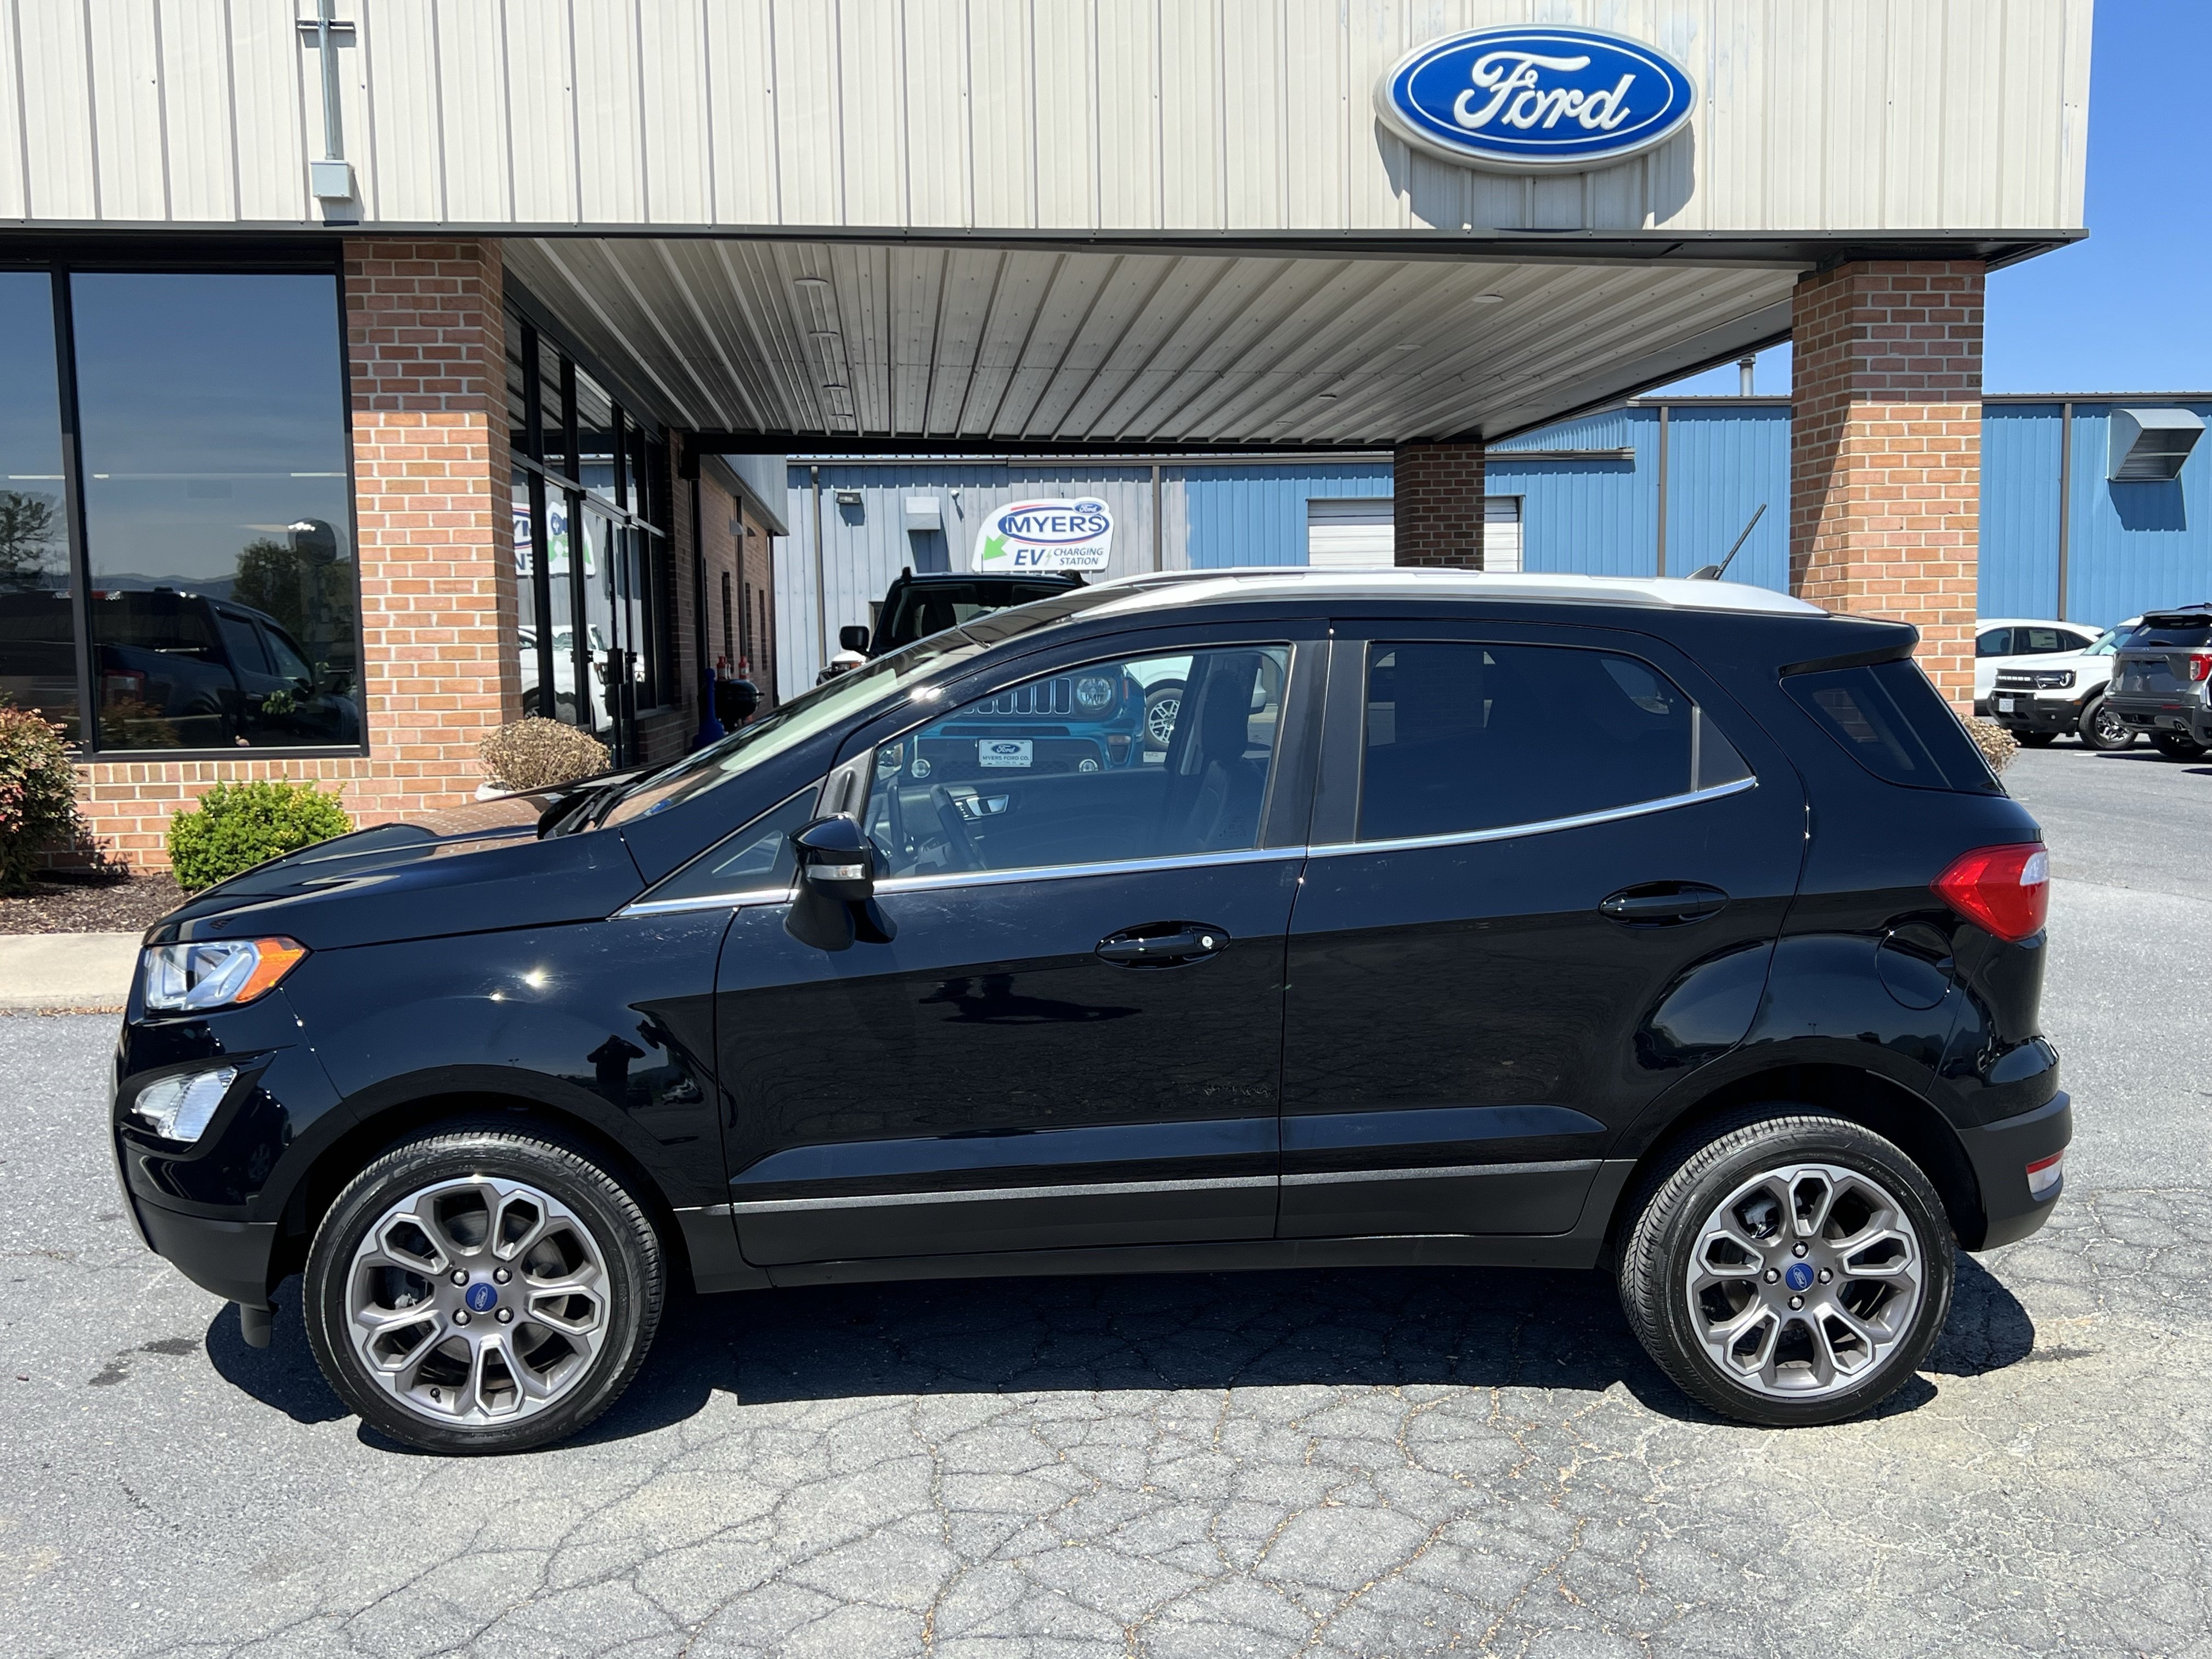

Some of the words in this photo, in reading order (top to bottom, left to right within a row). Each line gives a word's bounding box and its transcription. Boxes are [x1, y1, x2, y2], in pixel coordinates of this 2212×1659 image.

[1453, 51, 1636, 129] Ford
[1079, 503, 1098, 513] Ford
[1007, 516, 1104, 533] MYERS
[1014, 549, 1045, 566] EV
[1053, 548, 1103, 556] CHARGING
[1060, 557, 1098, 566] STATION
